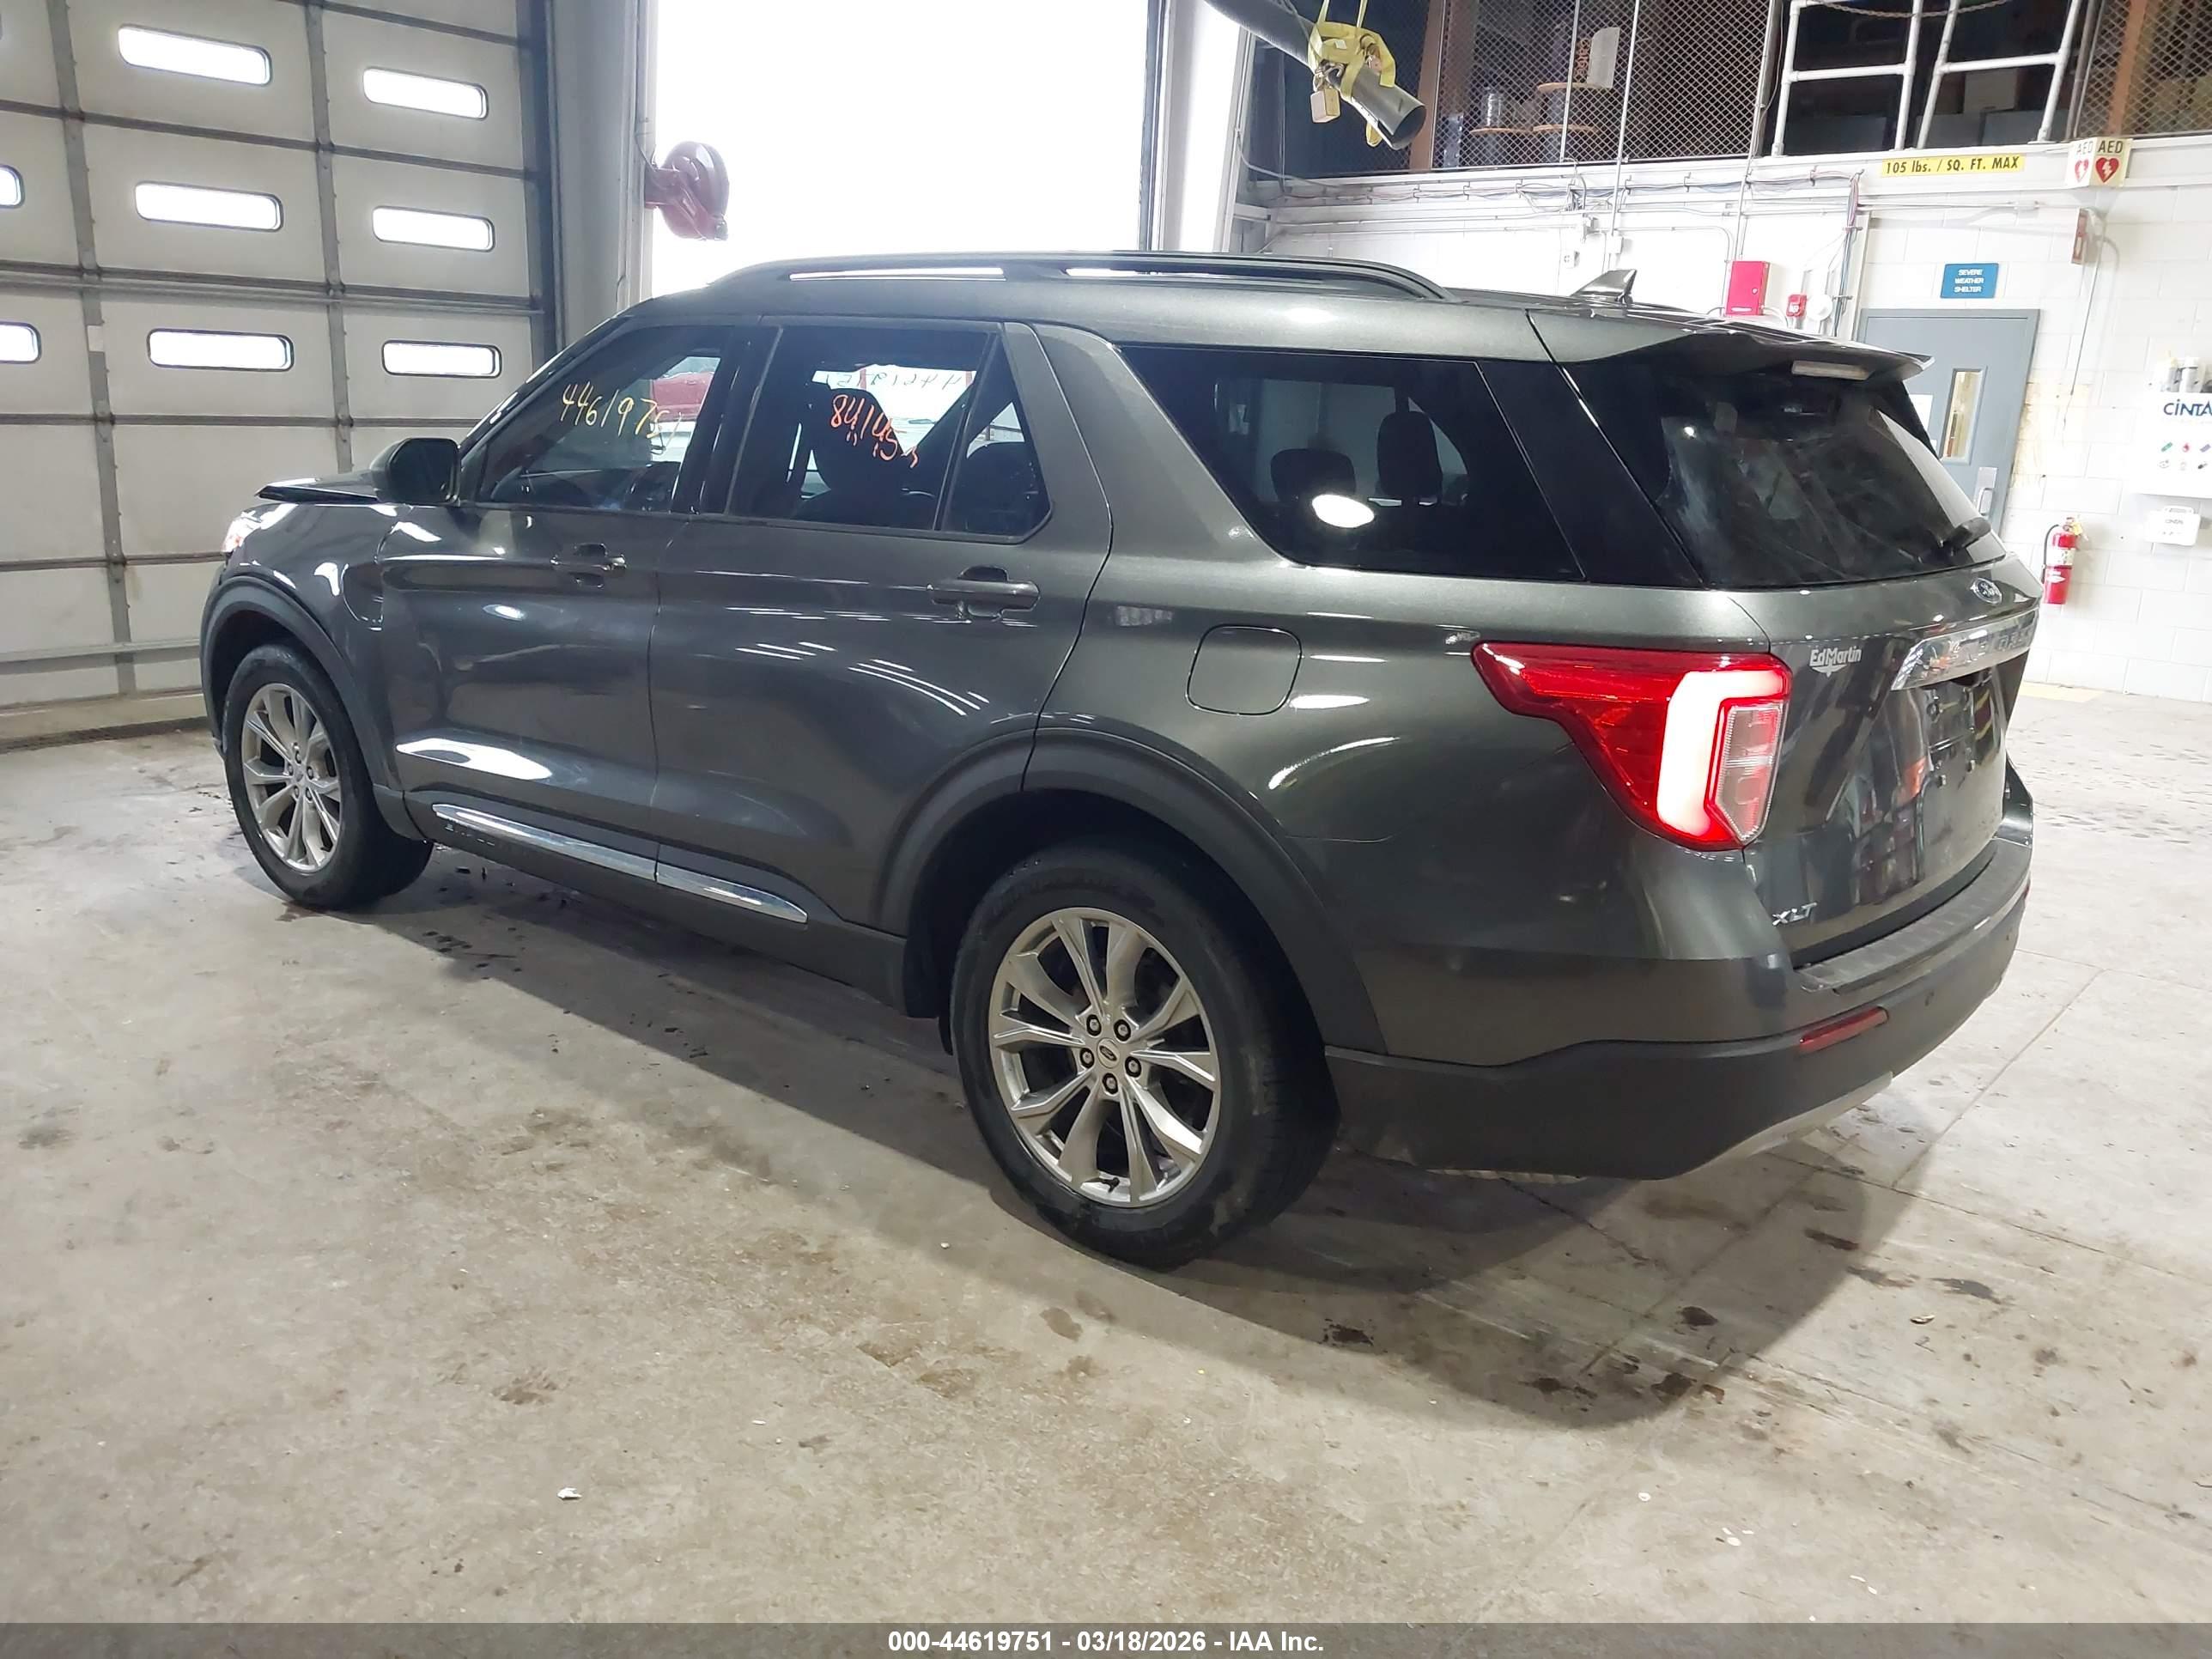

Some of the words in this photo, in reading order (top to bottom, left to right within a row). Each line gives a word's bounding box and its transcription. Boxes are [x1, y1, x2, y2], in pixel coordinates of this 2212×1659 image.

[2098, 140, 2124, 154] AED
[1887, 162, 1907, 173] 105
[1911, 161, 1931, 173] lbs.
[1936, 159, 1942, 172] /
[1947, 159, 1964, 172] SQ.
[1971, 158, 1986, 170] FT.
[1992, 156, 2020, 169] MAX
[1771, 902, 1818, 927] XLT
